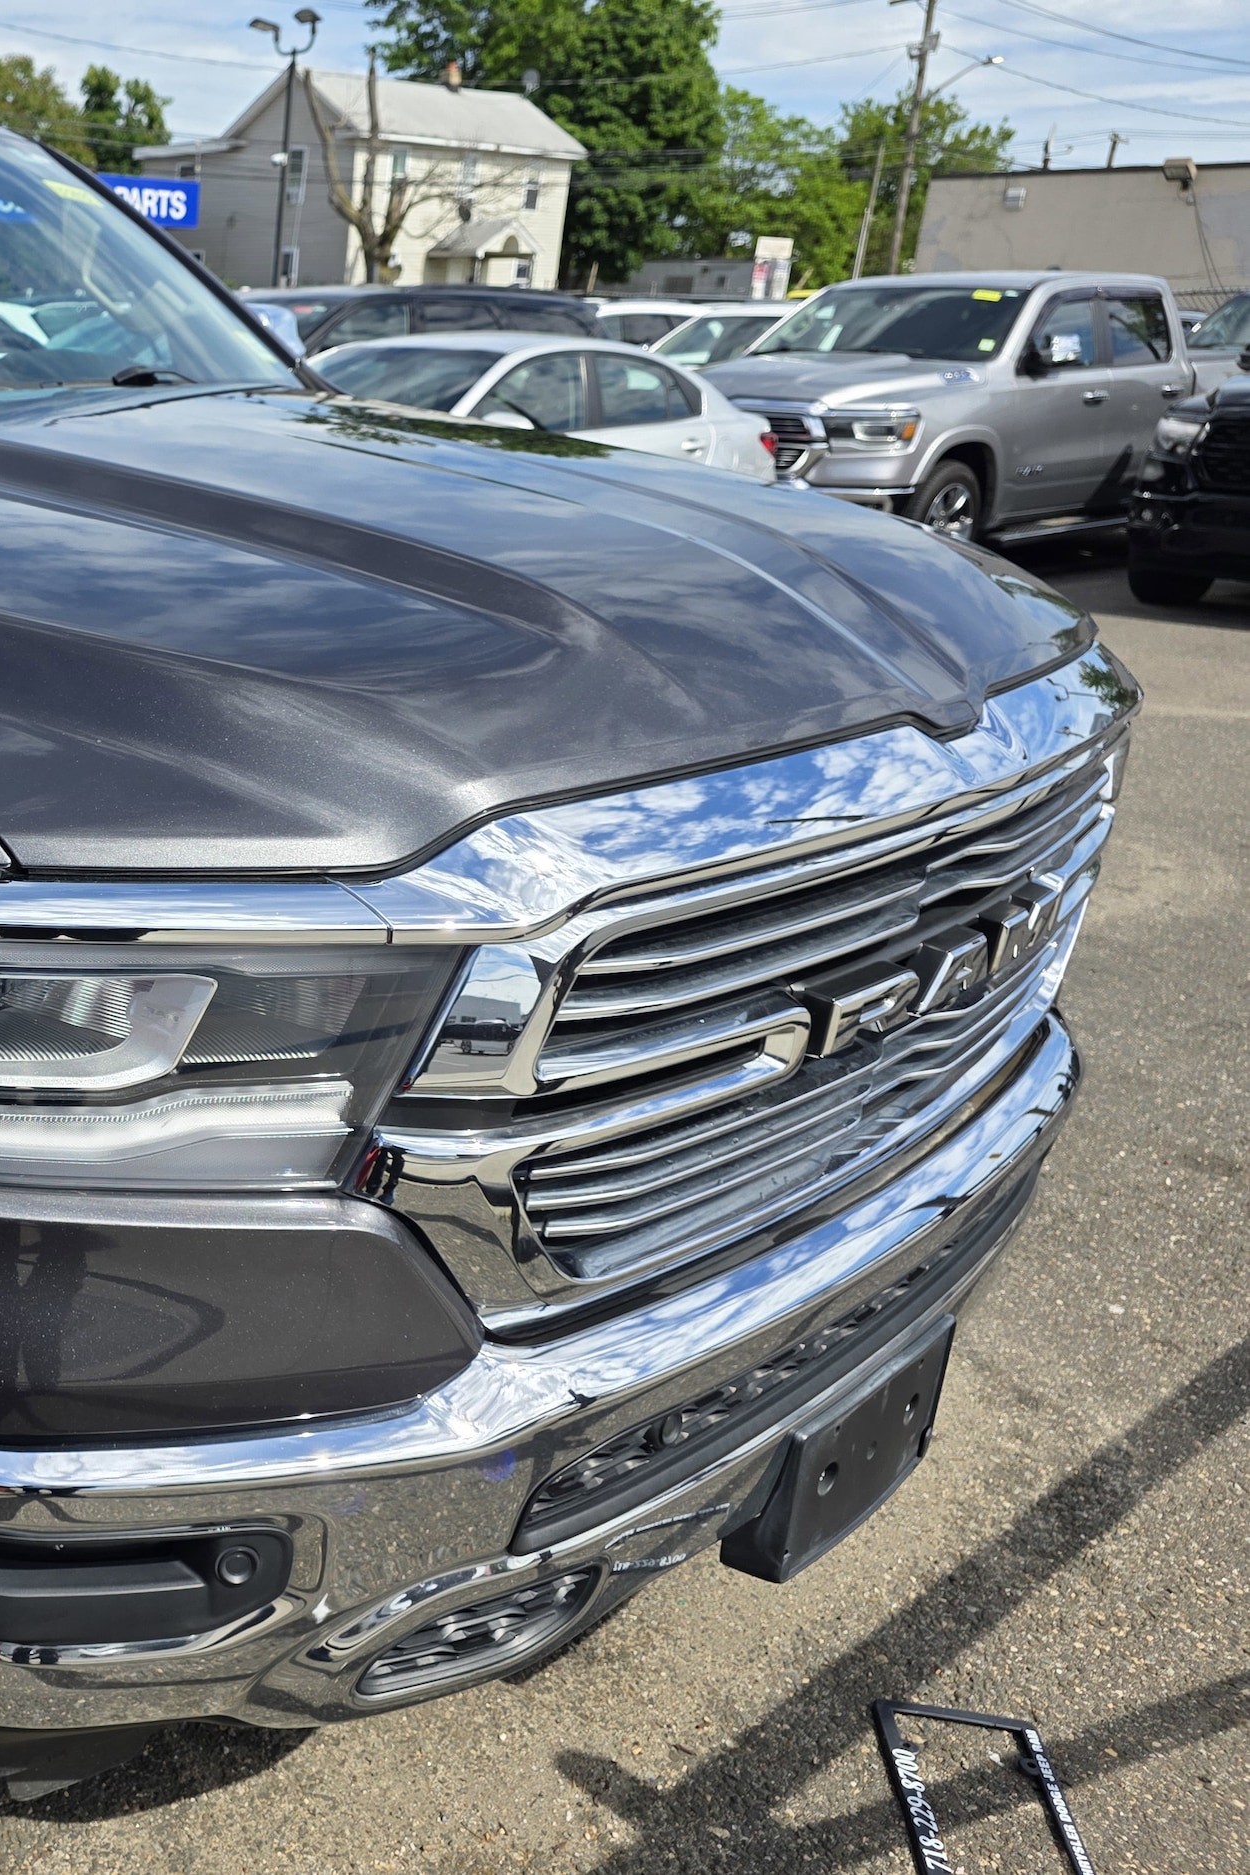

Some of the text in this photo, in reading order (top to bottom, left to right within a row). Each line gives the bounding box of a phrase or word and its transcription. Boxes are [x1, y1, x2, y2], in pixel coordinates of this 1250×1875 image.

[805, 876, 1062, 1058] RAM
[891, 1748, 954, 1874] 718-229-8700
[1025, 1729, 1096, 1875] HRYSLER DODGE JEEP RAM
